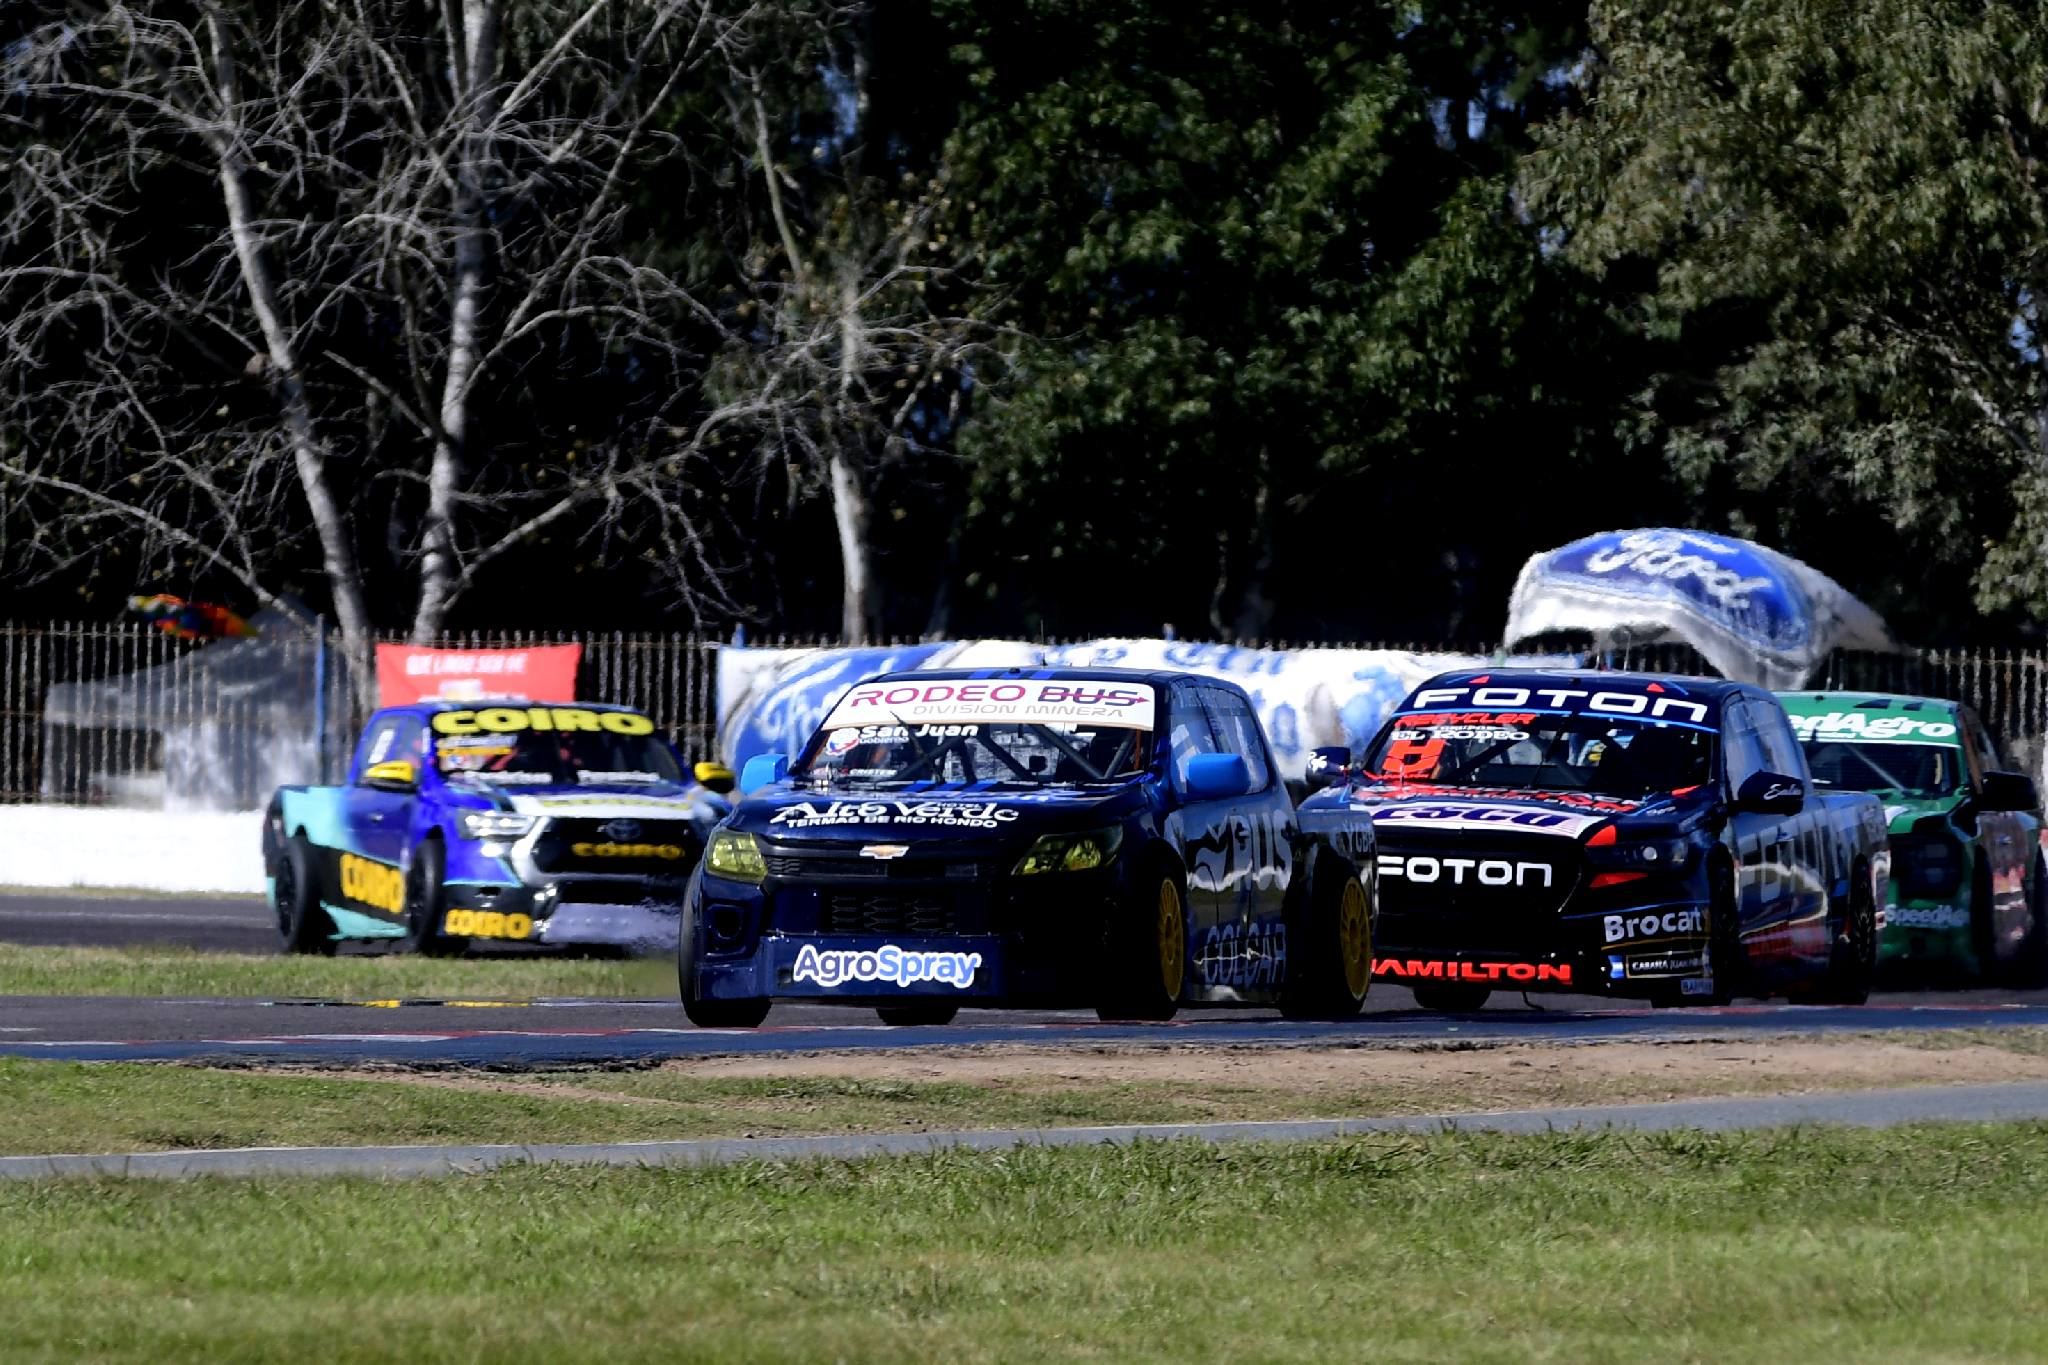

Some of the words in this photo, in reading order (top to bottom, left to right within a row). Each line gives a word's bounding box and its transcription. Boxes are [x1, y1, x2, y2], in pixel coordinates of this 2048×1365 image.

[851, 685, 1026, 707] RODEO
[1038, 686, 1142, 707] BUS
[1414, 688, 1708, 722] FOTON
[432, 708, 654, 735] COIRO
[913, 704, 1017, 714] DIVISION
[1026, 705, 1123, 717] MINERA
[860, 725, 909, 738] San
[915, 723, 979, 746] Juan
[1391, 731, 1426, 741] EL
[1431, 730, 1530, 741] RODEO
[770, 801, 886, 824] Alto
[889, 801, 1019, 822] Verde
[787, 816, 860, 829] TERMAS
[866, 815, 890, 824] DE
[894, 815, 927, 824] RIO
[930, 817, 998, 828] HONDO
[340, 853, 405, 914] COIRO
[444, 909, 532, 939] COIRO
[794, 946, 981, 987] AgroSpray
[1371, 959, 1573, 984] AMILTON
